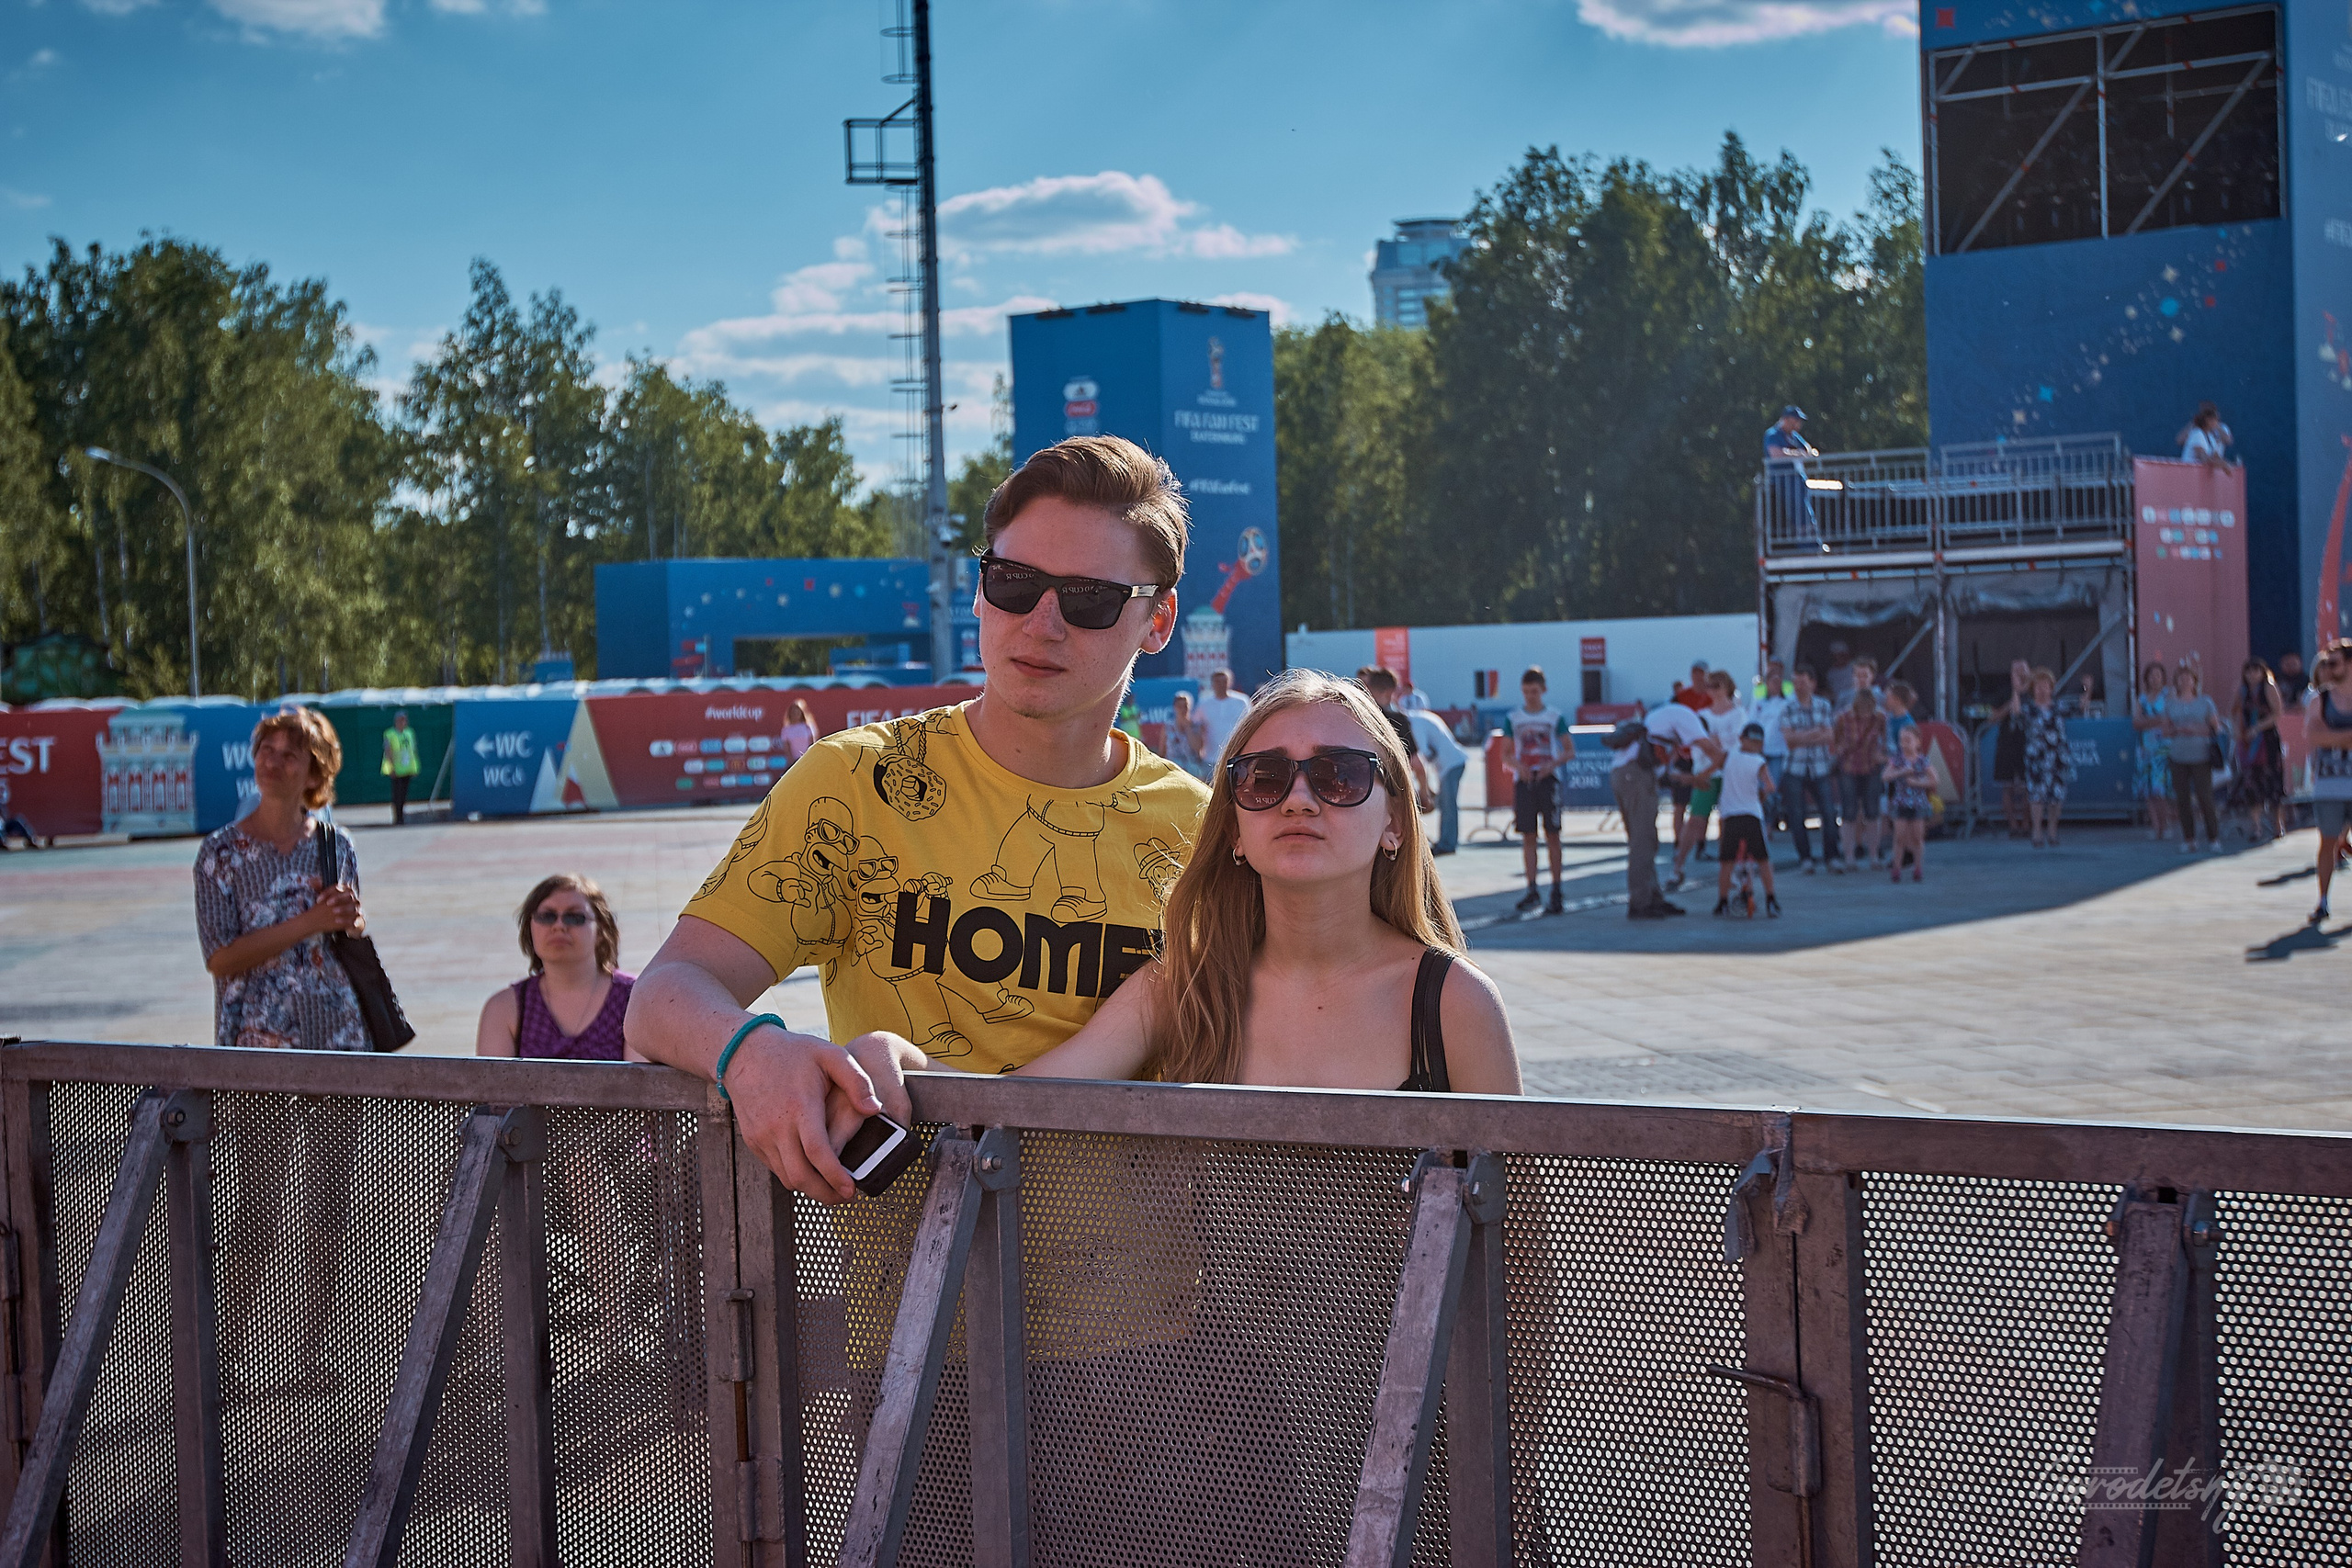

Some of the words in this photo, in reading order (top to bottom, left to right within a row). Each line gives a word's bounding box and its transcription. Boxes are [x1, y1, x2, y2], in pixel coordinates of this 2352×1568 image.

[705, 704, 763, 721] #worldcup
[494, 730, 534, 759] WC
[482, 764, 514, 787] WC
[891, 891, 1167, 998] HOME
